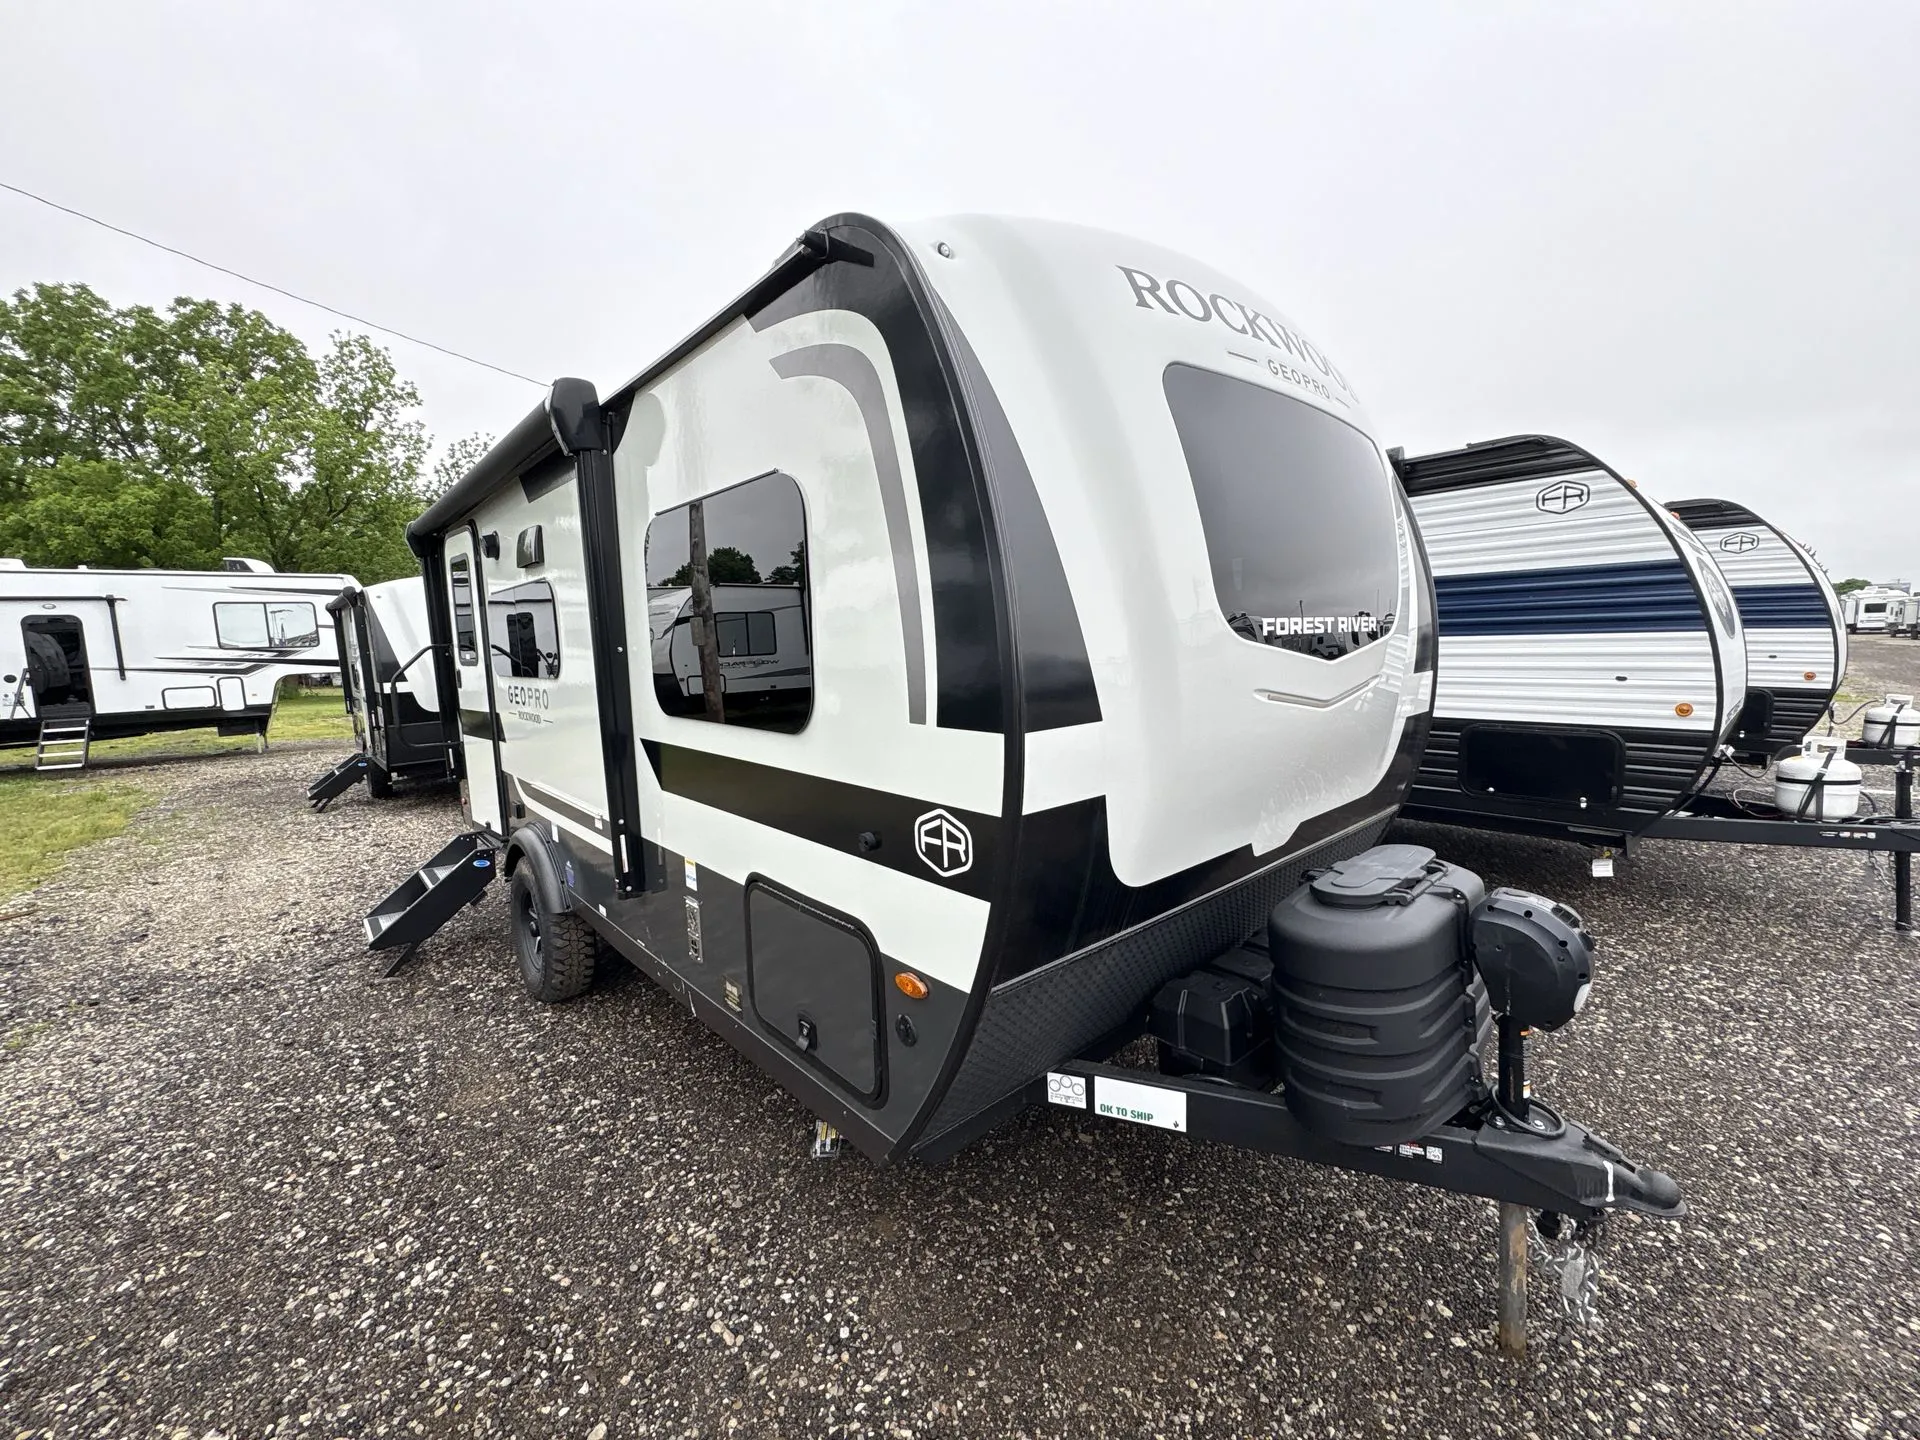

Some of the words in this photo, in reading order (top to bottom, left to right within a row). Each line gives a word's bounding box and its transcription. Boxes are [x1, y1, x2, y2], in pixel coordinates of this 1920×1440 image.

[1267, 358, 1331, 400] GEOPRO
[1261, 616, 1335, 636] FOREST
[1337, 616, 1378, 633] RIVER
[507, 685, 549, 710] GEOPRO
[1099, 1103, 1114, 1114] OK
[1115, 1106, 1128, 1117] TO
[1130, 1109, 1154, 1122] SHIP
